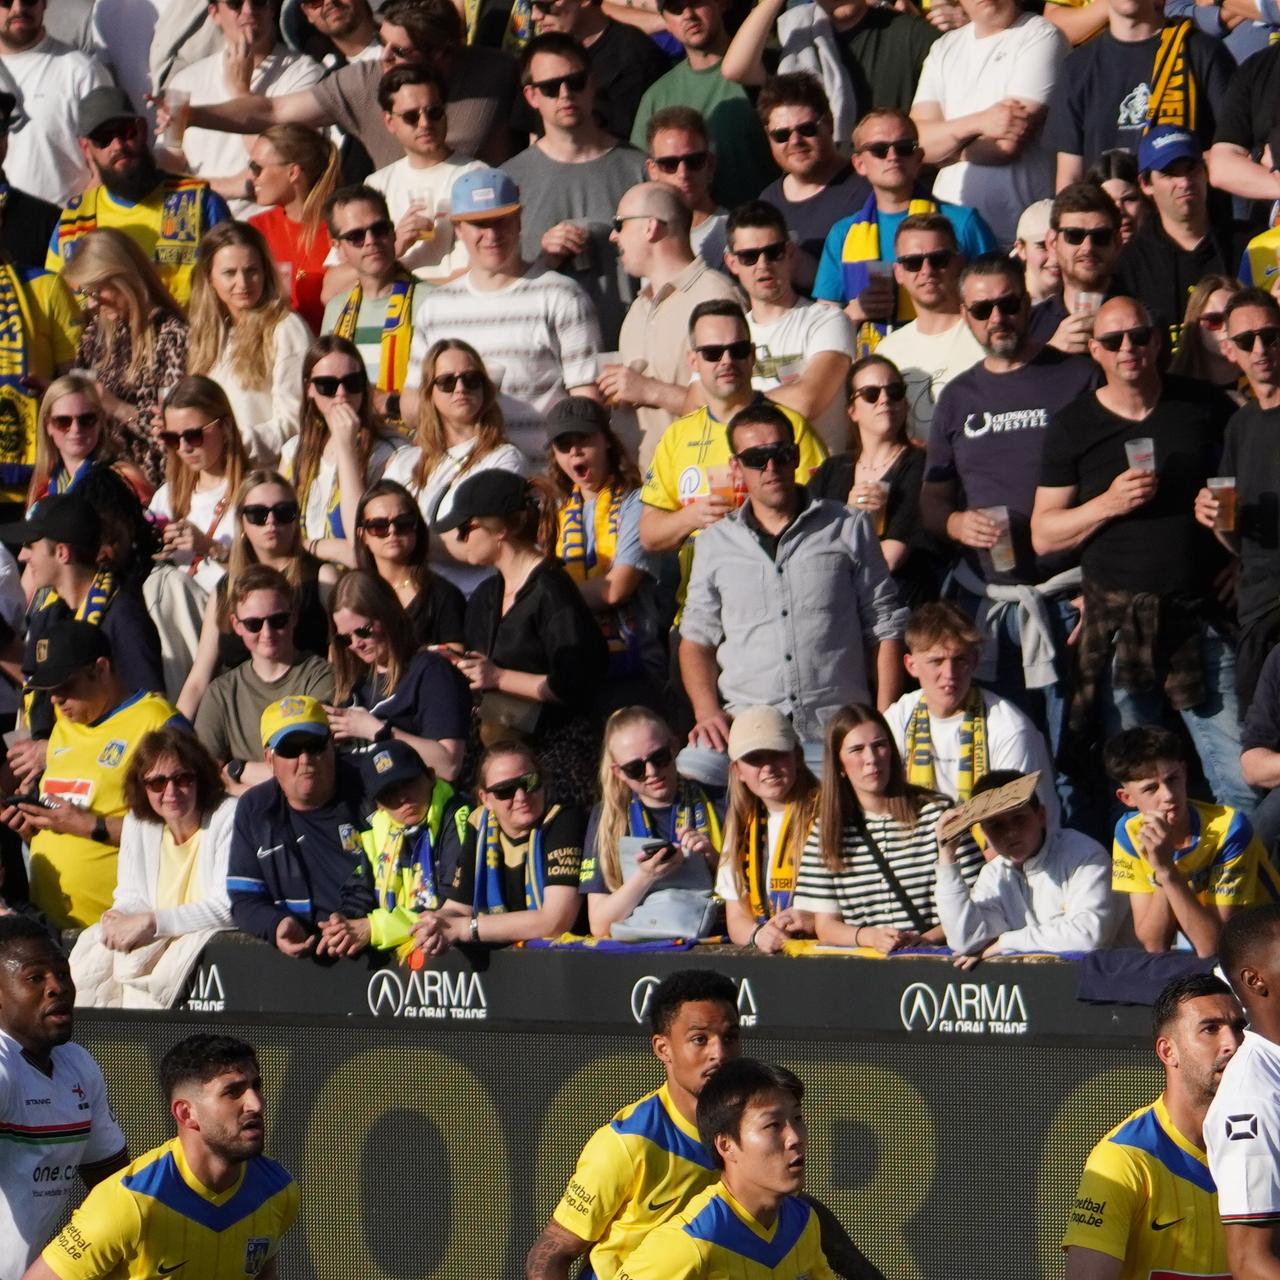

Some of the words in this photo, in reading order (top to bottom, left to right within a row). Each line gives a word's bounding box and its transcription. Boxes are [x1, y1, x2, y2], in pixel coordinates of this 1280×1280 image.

[992, 408, 1047, 423] OLDSKOOL
[992, 417, 1048, 432] WESTEL
[404, 970, 487, 1007] ARMA
[940, 984, 1027, 1021] ARMA
[404, 1006, 447, 1018] GLOBAL
[450, 1007, 487, 1019] TRADE
[940, 1020, 983, 1033] GLOBAL
[988, 1022, 1027, 1034] TRADE
